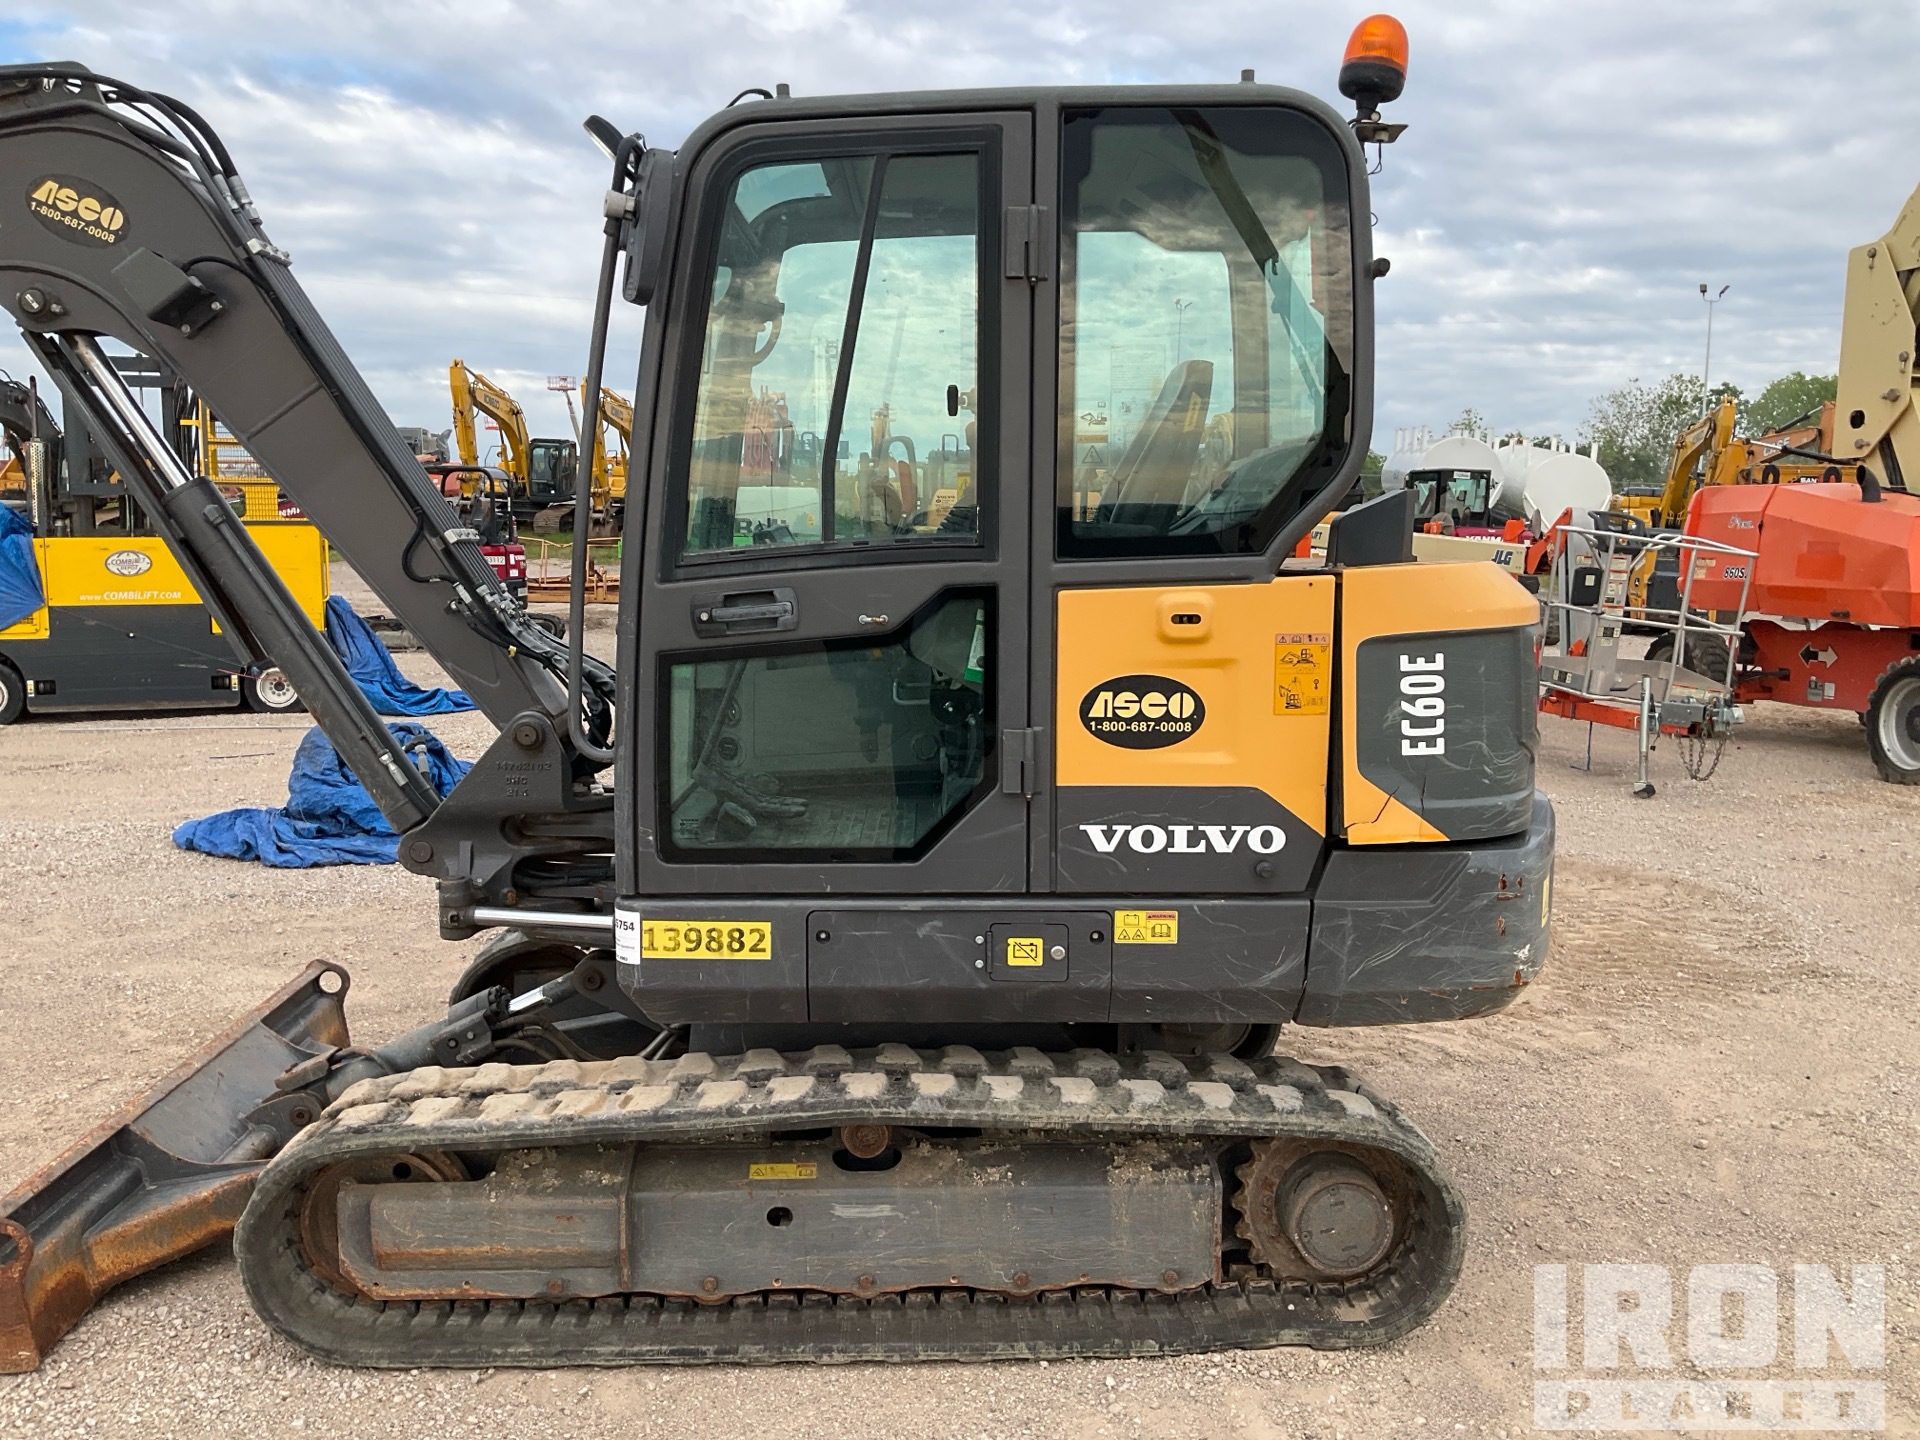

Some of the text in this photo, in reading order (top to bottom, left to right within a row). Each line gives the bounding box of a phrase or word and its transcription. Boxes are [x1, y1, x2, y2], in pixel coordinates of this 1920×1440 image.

[32, 180, 124, 231] ASCO
[30, 201, 115, 243] 1-800-687-0008
[1491, 549, 1514, 566] JLG
[1088, 691, 1195, 719] ASCO
[1400, 652, 1445, 756] EC60E
[1090, 721, 1192, 732] 1-800-687-0008
[1079, 824, 1287, 854] VOLVO
[643, 927, 767, 953] 139882
